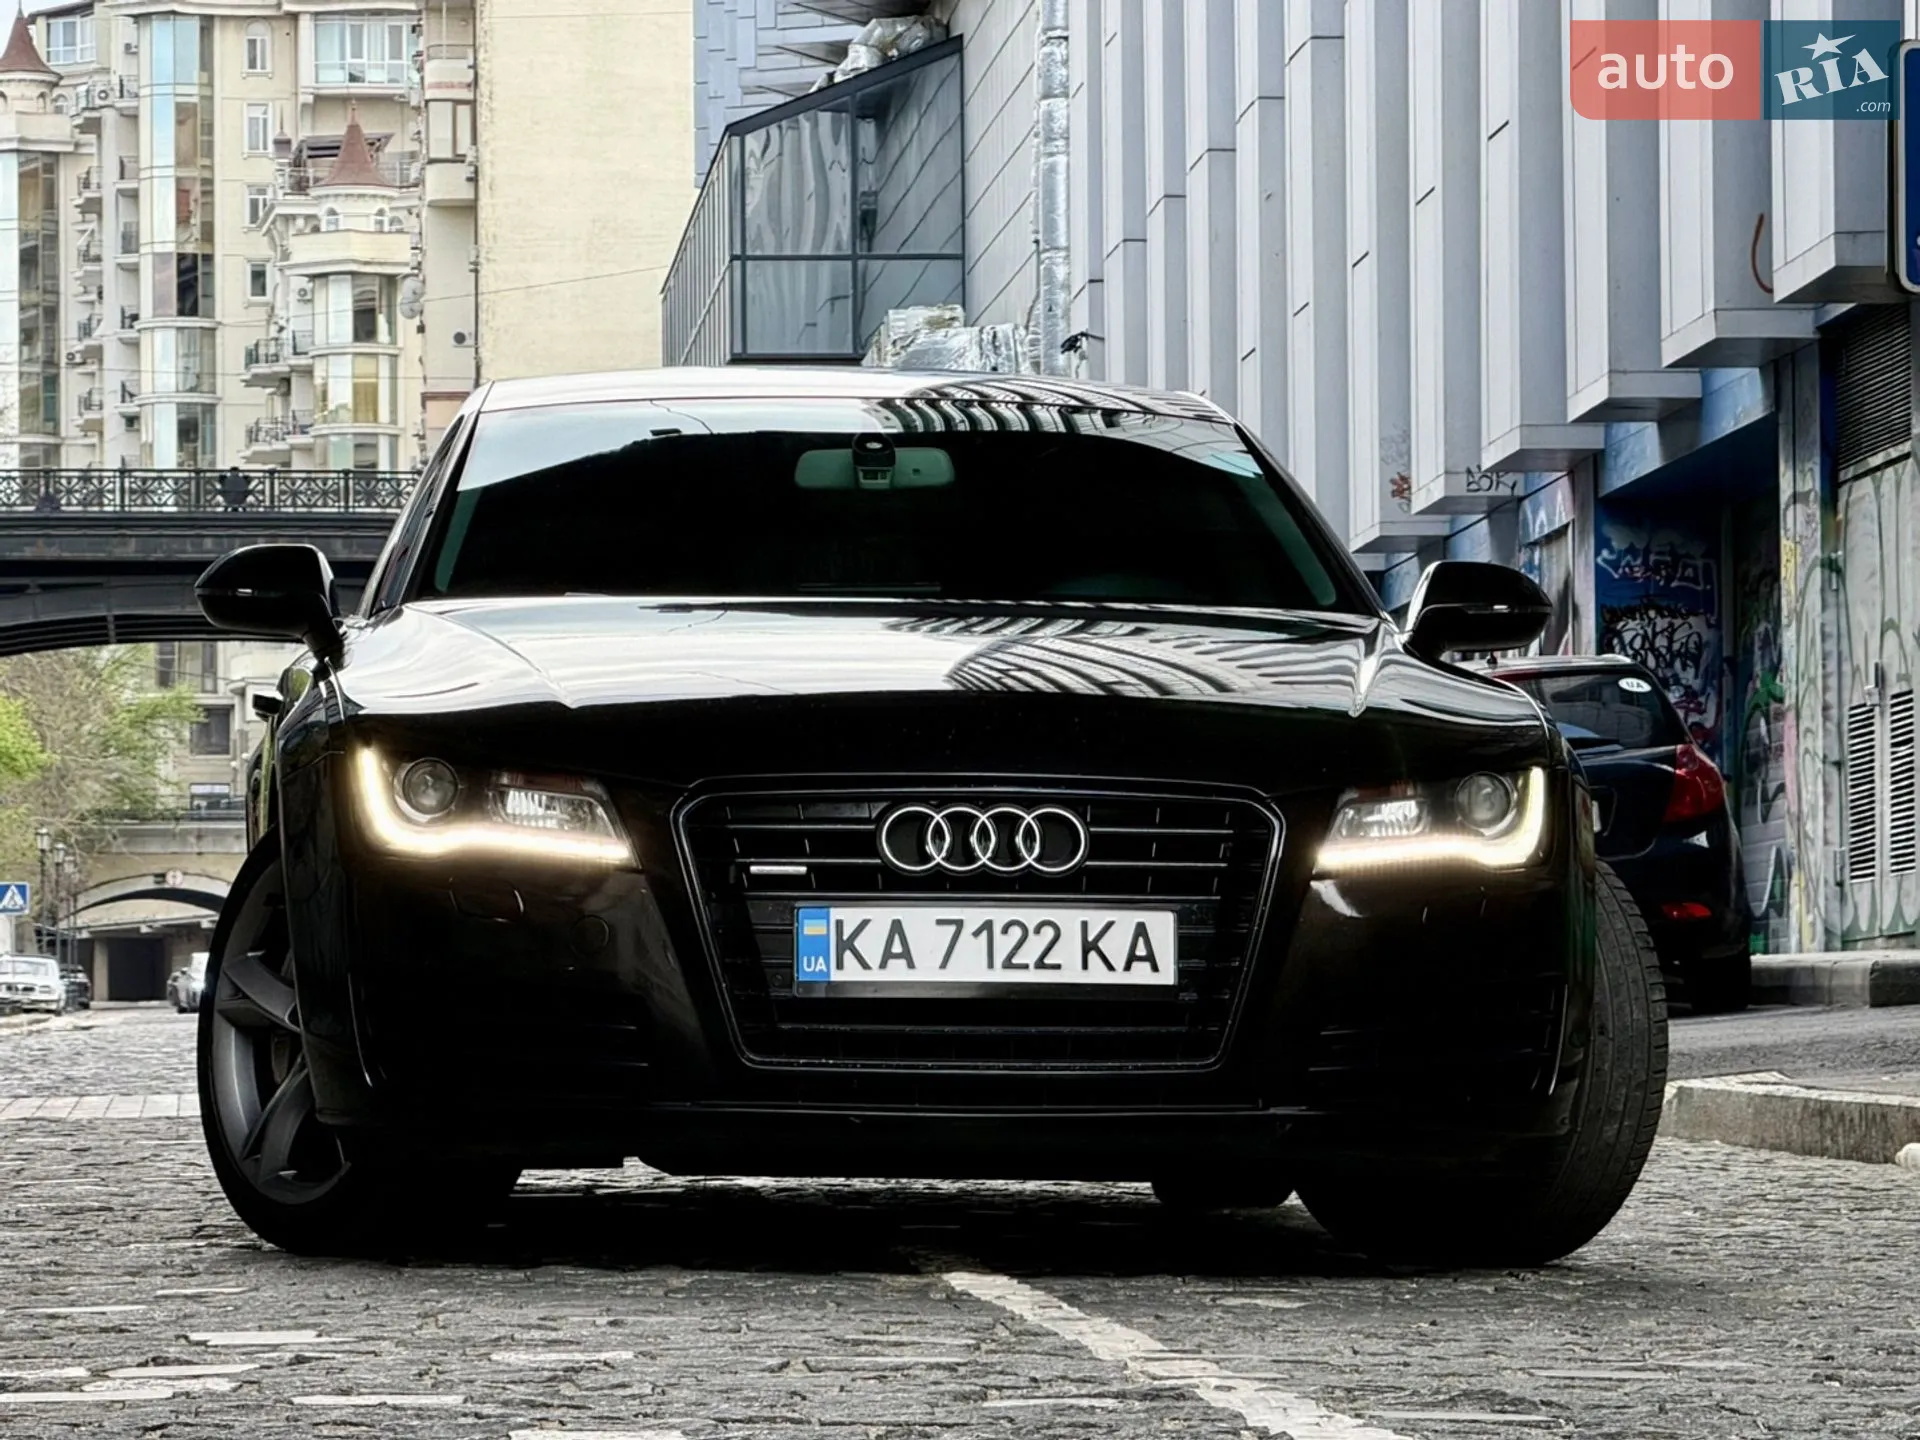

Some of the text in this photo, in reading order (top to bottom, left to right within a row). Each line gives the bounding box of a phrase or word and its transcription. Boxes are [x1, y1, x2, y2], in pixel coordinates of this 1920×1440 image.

[834, 918, 1160, 973] KA 7122 KA
[802, 956, 828, 973] UA
